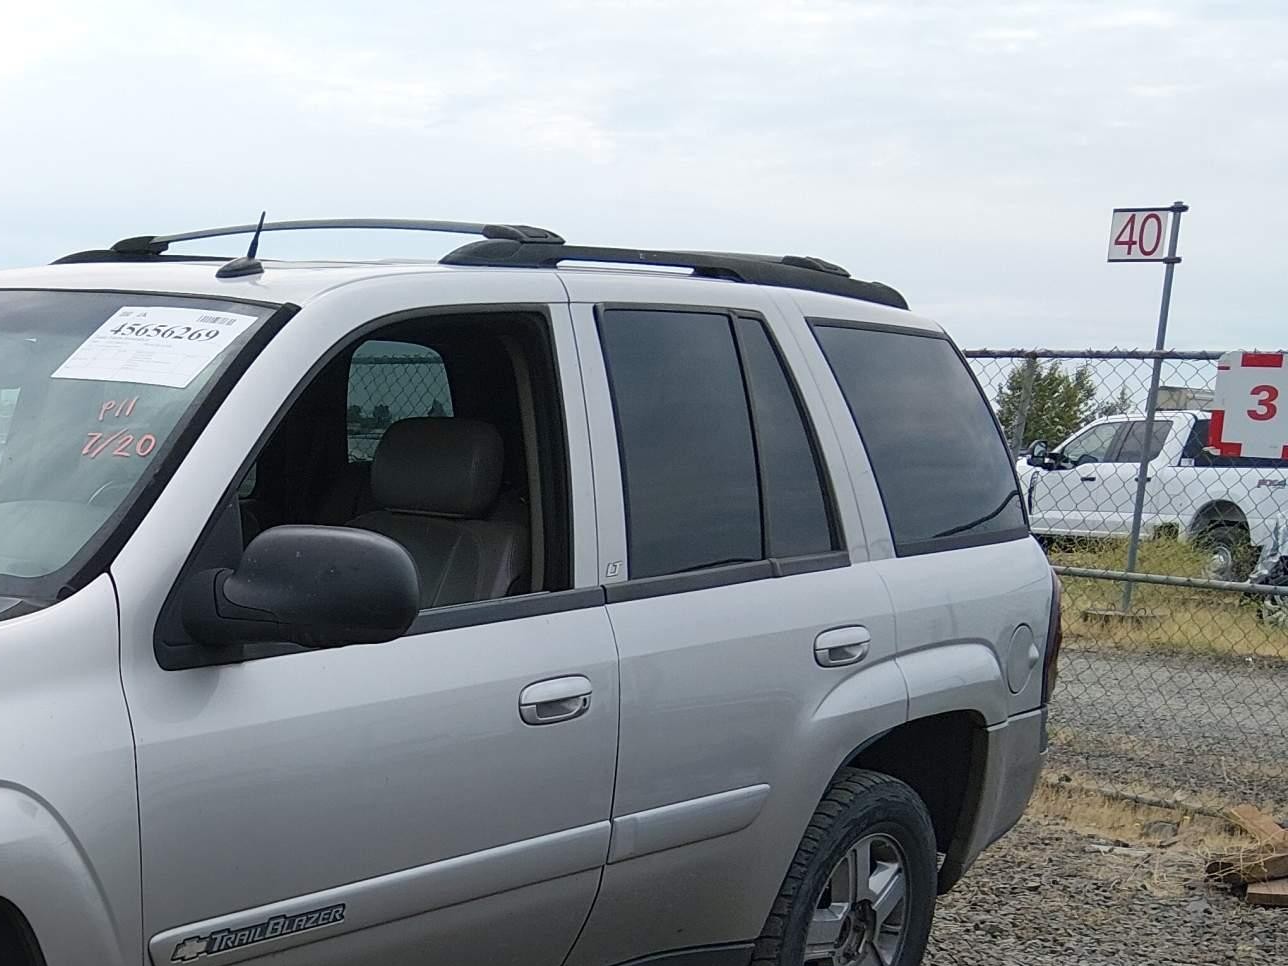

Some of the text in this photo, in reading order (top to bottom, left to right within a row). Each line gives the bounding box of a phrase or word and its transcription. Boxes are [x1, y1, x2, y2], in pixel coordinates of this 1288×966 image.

[1114, 213, 1162, 256] 40
[110, 322, 220, 342] 45656269
[1247, 384, 1279, 421] 3
[82, 428, 156, 459] 7/20
